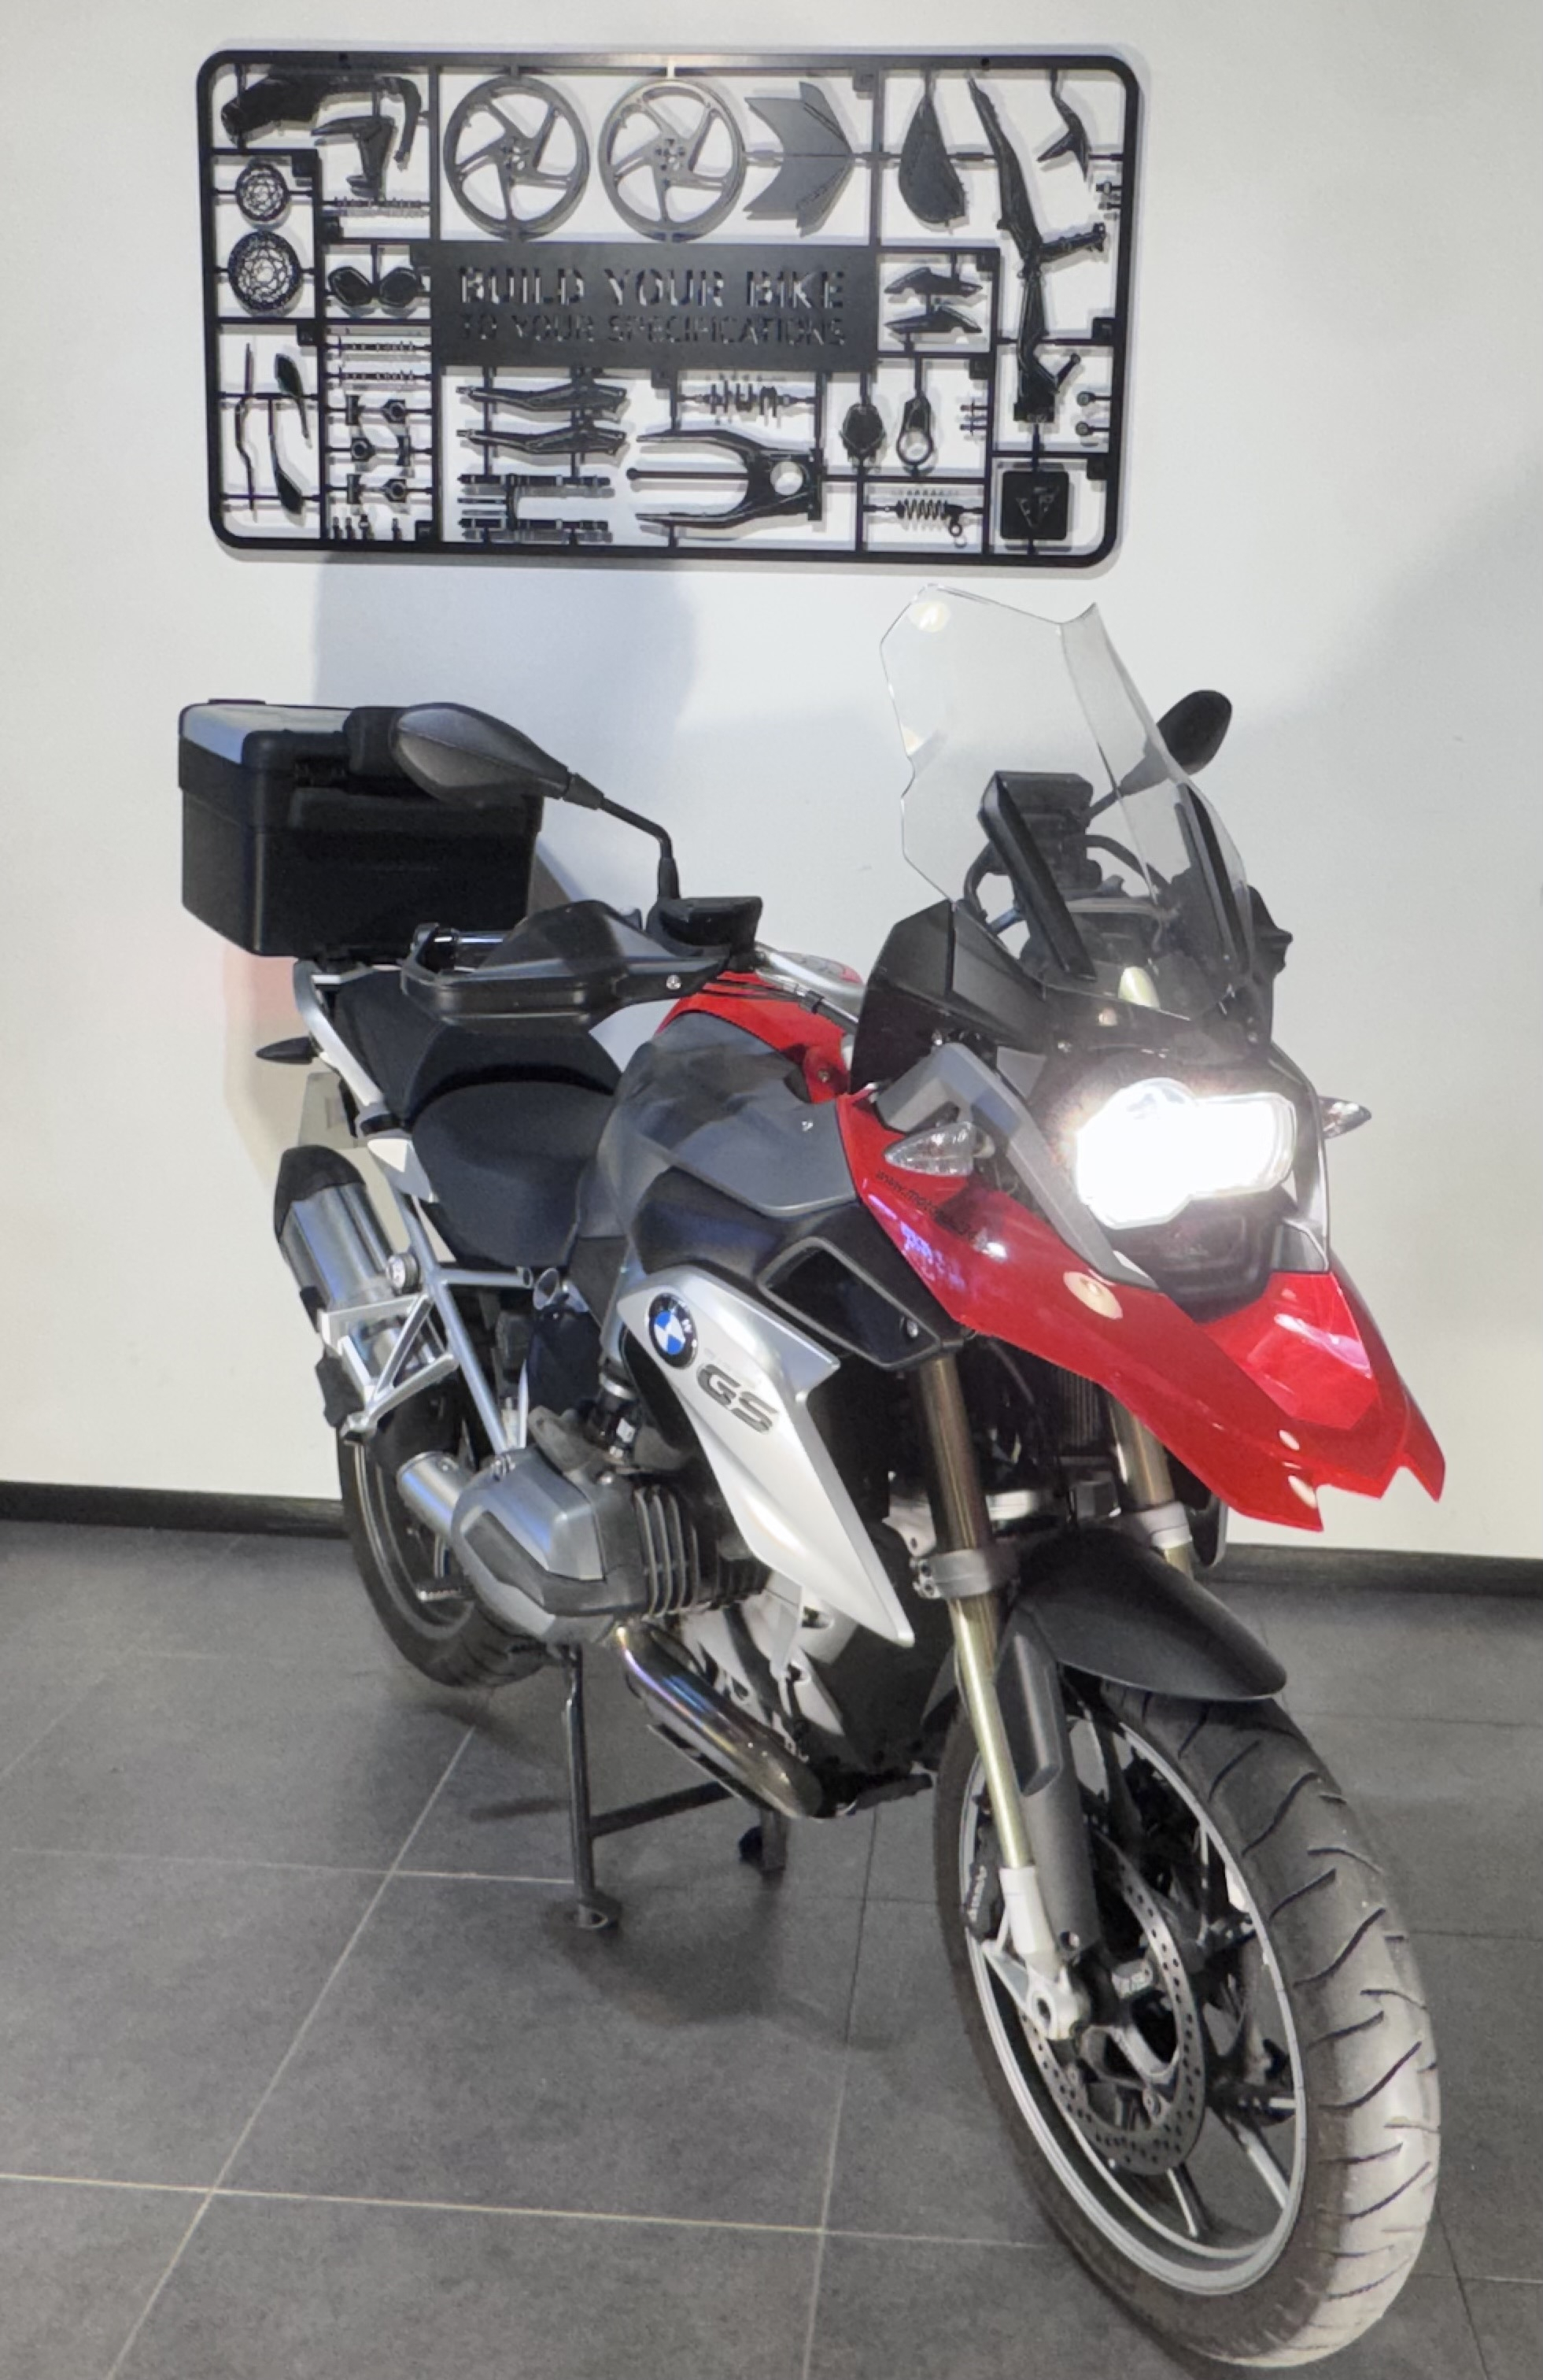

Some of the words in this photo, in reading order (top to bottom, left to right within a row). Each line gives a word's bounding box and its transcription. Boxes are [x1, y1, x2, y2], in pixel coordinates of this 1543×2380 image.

[459, 268, 585, 305] BUILD
[604, 268, 724, 307] YOUR
[747, 271, 845, 309] BIKE
[460, 314, 498, 341] TO
[511, 314, 595, 342] YOUR
[608, 315, 847, 346] SPECIFICATIONS
[696, 1362, 781, 1435] GS
